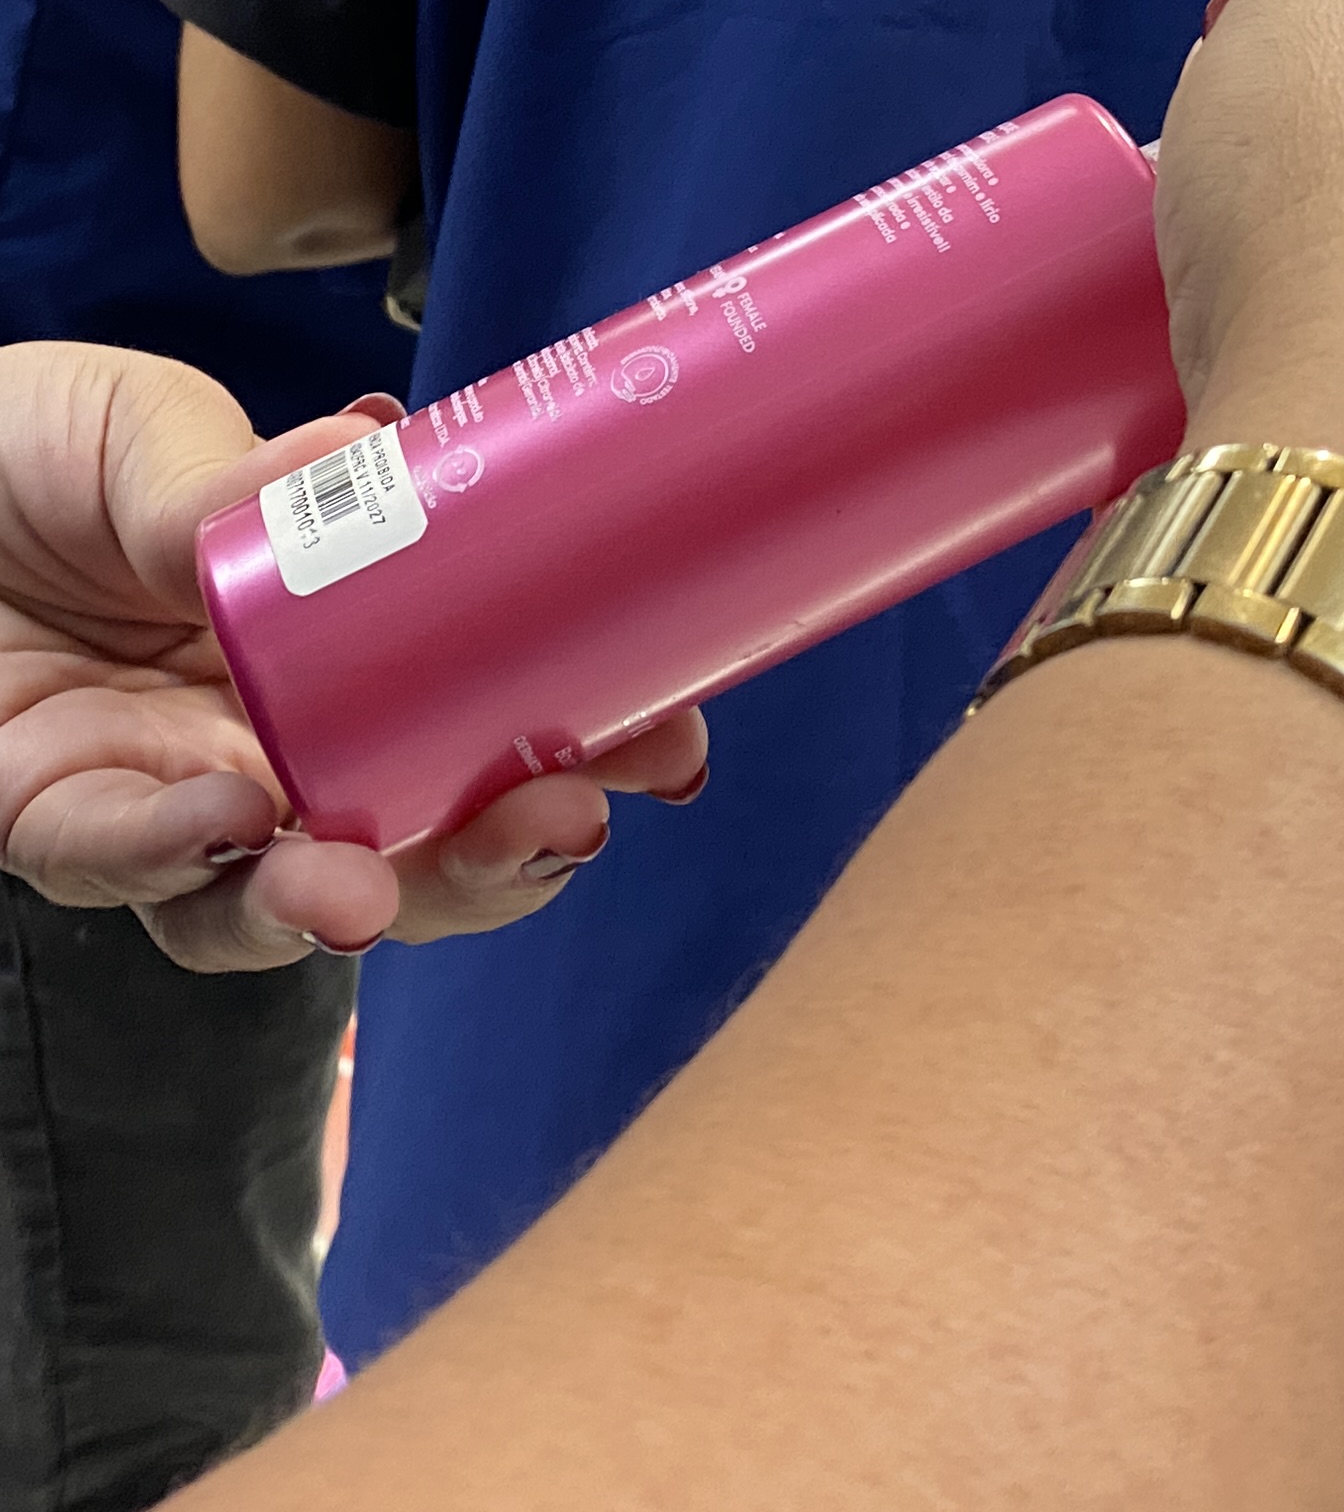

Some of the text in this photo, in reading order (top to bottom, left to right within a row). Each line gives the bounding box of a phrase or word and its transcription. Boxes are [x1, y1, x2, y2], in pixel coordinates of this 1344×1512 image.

[937, 206, 954, 224] da
[979, 198, 1001, 224] lírio
[720, 300, 755, 353] FOUNDED
[737, 292, 767, 332] FEMALE
[372, 446, 395, 493] PROIBIDA
